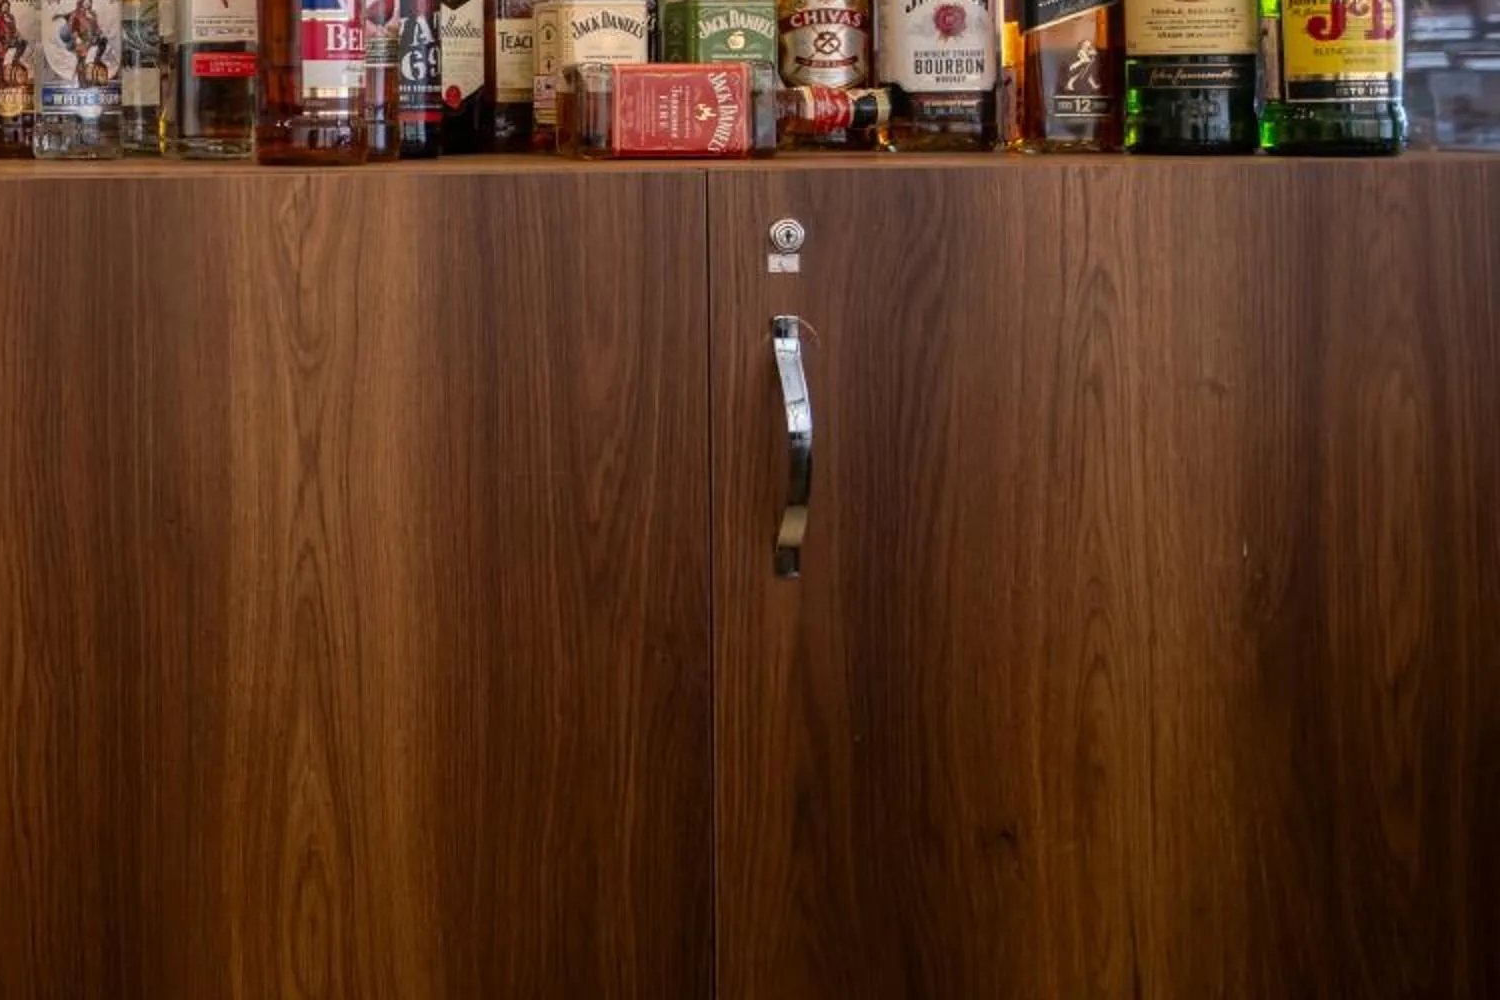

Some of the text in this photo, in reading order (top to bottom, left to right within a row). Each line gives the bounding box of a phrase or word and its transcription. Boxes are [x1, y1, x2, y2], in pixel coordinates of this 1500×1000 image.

[571, 15, 600, 40] JACK
[698, 14, 728, 39] JACK
[789, 8, 862, 28] CHIVAS
[914, 58, 985, 76] BOURBON
[708, 72, 733, 105] JACK
[1074, 99, 1091, 113] 12
